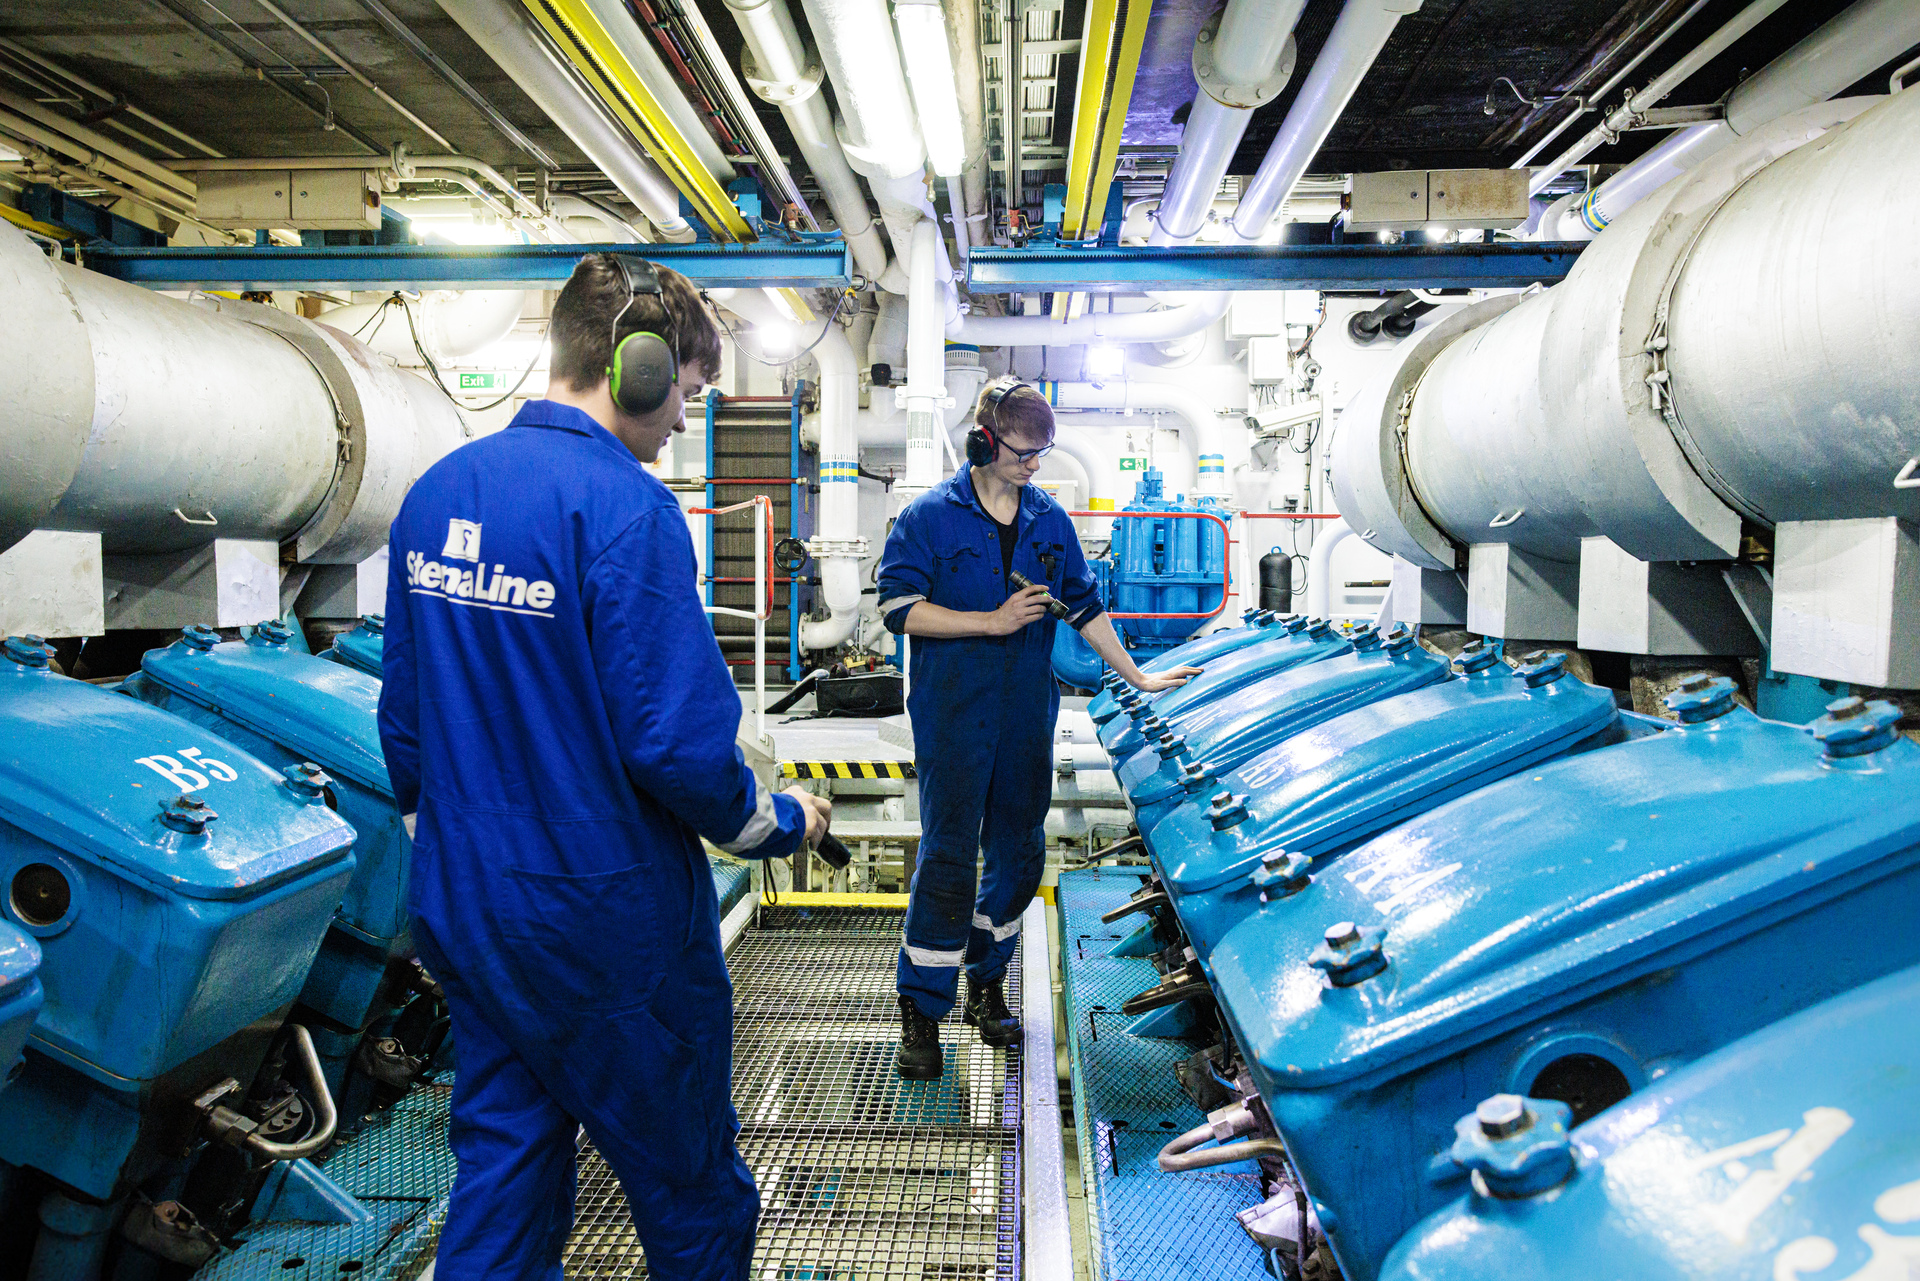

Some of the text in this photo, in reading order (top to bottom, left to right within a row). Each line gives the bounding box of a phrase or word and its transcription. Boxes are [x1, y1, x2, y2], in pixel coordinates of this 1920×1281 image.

[462, 376, 485, 387] Exit
[133, 746, 238, 794] B5
[1237, 748, 1297, 789] A5
